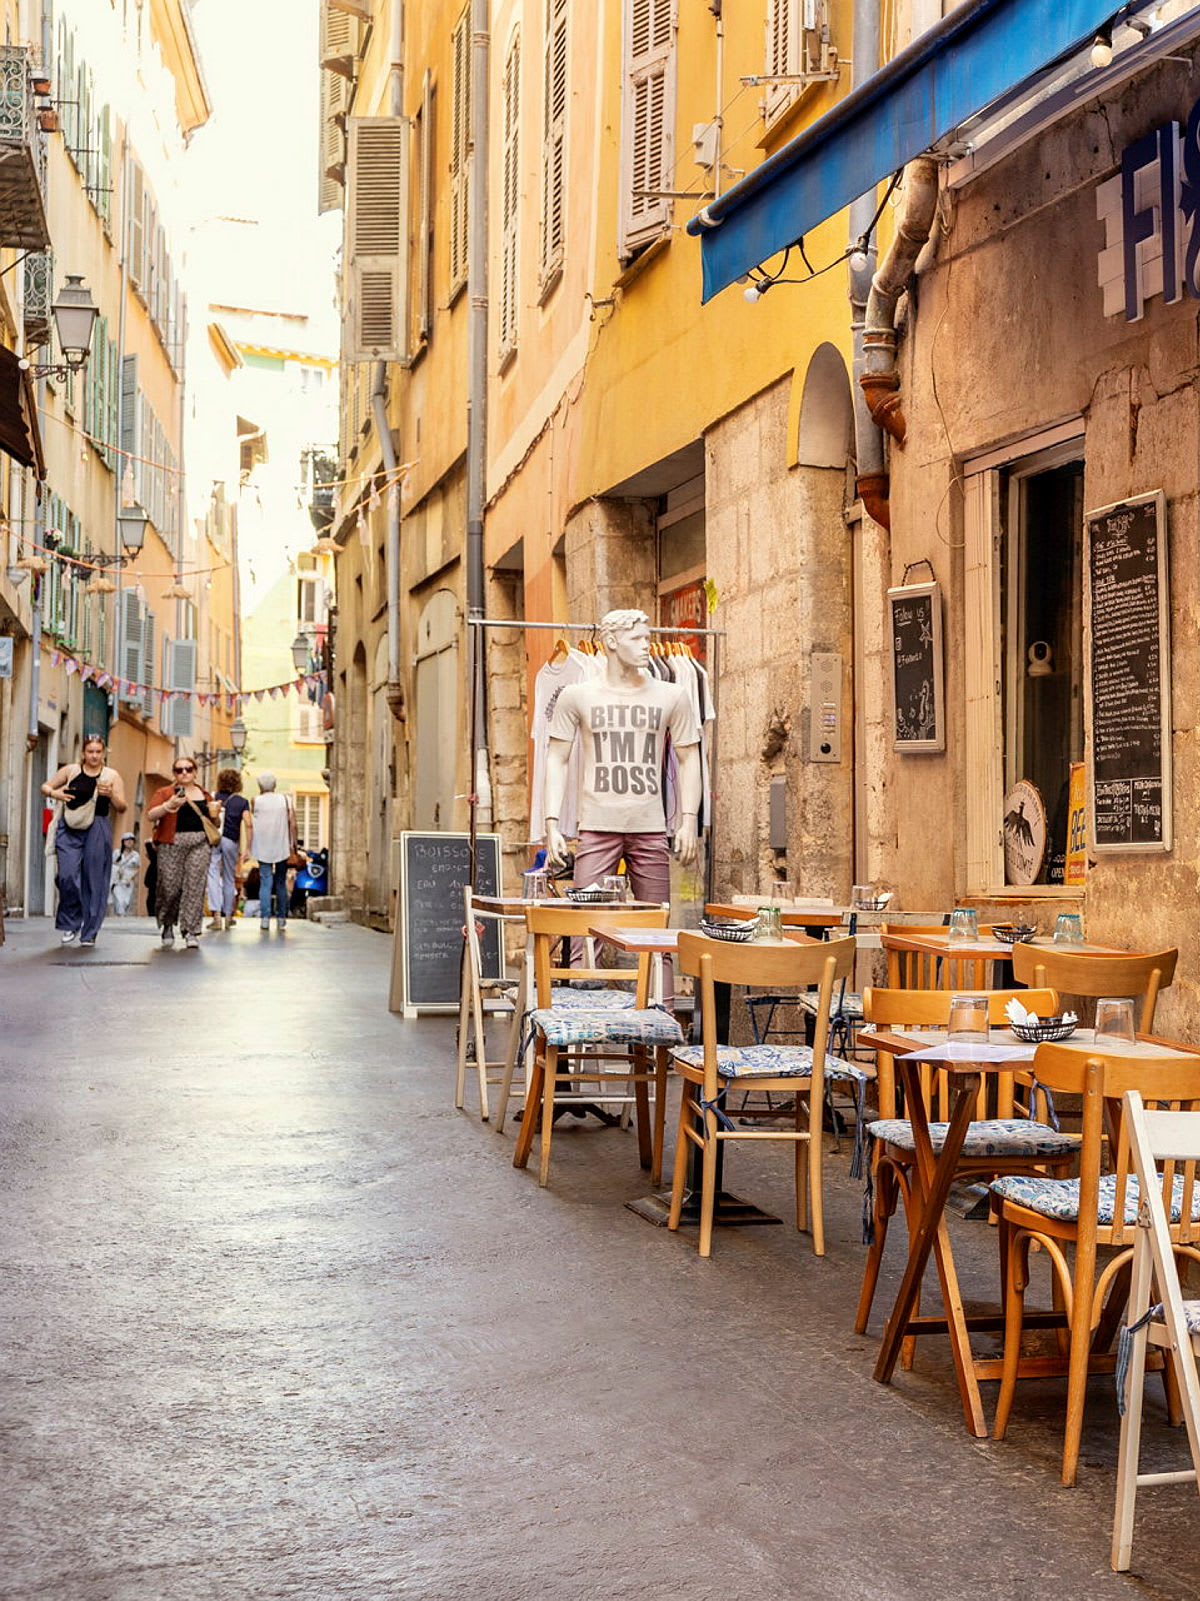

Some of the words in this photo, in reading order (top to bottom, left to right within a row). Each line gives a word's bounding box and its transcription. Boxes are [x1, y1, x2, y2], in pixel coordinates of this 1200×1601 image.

[591, 704, 662, 731] B!TCH
[592, 731, 635, 763] I'M
[642, 732, 657, 765] A
[593, 765, 659, 796] BOSS
[415, 844, 488, 860] BOISSOS
